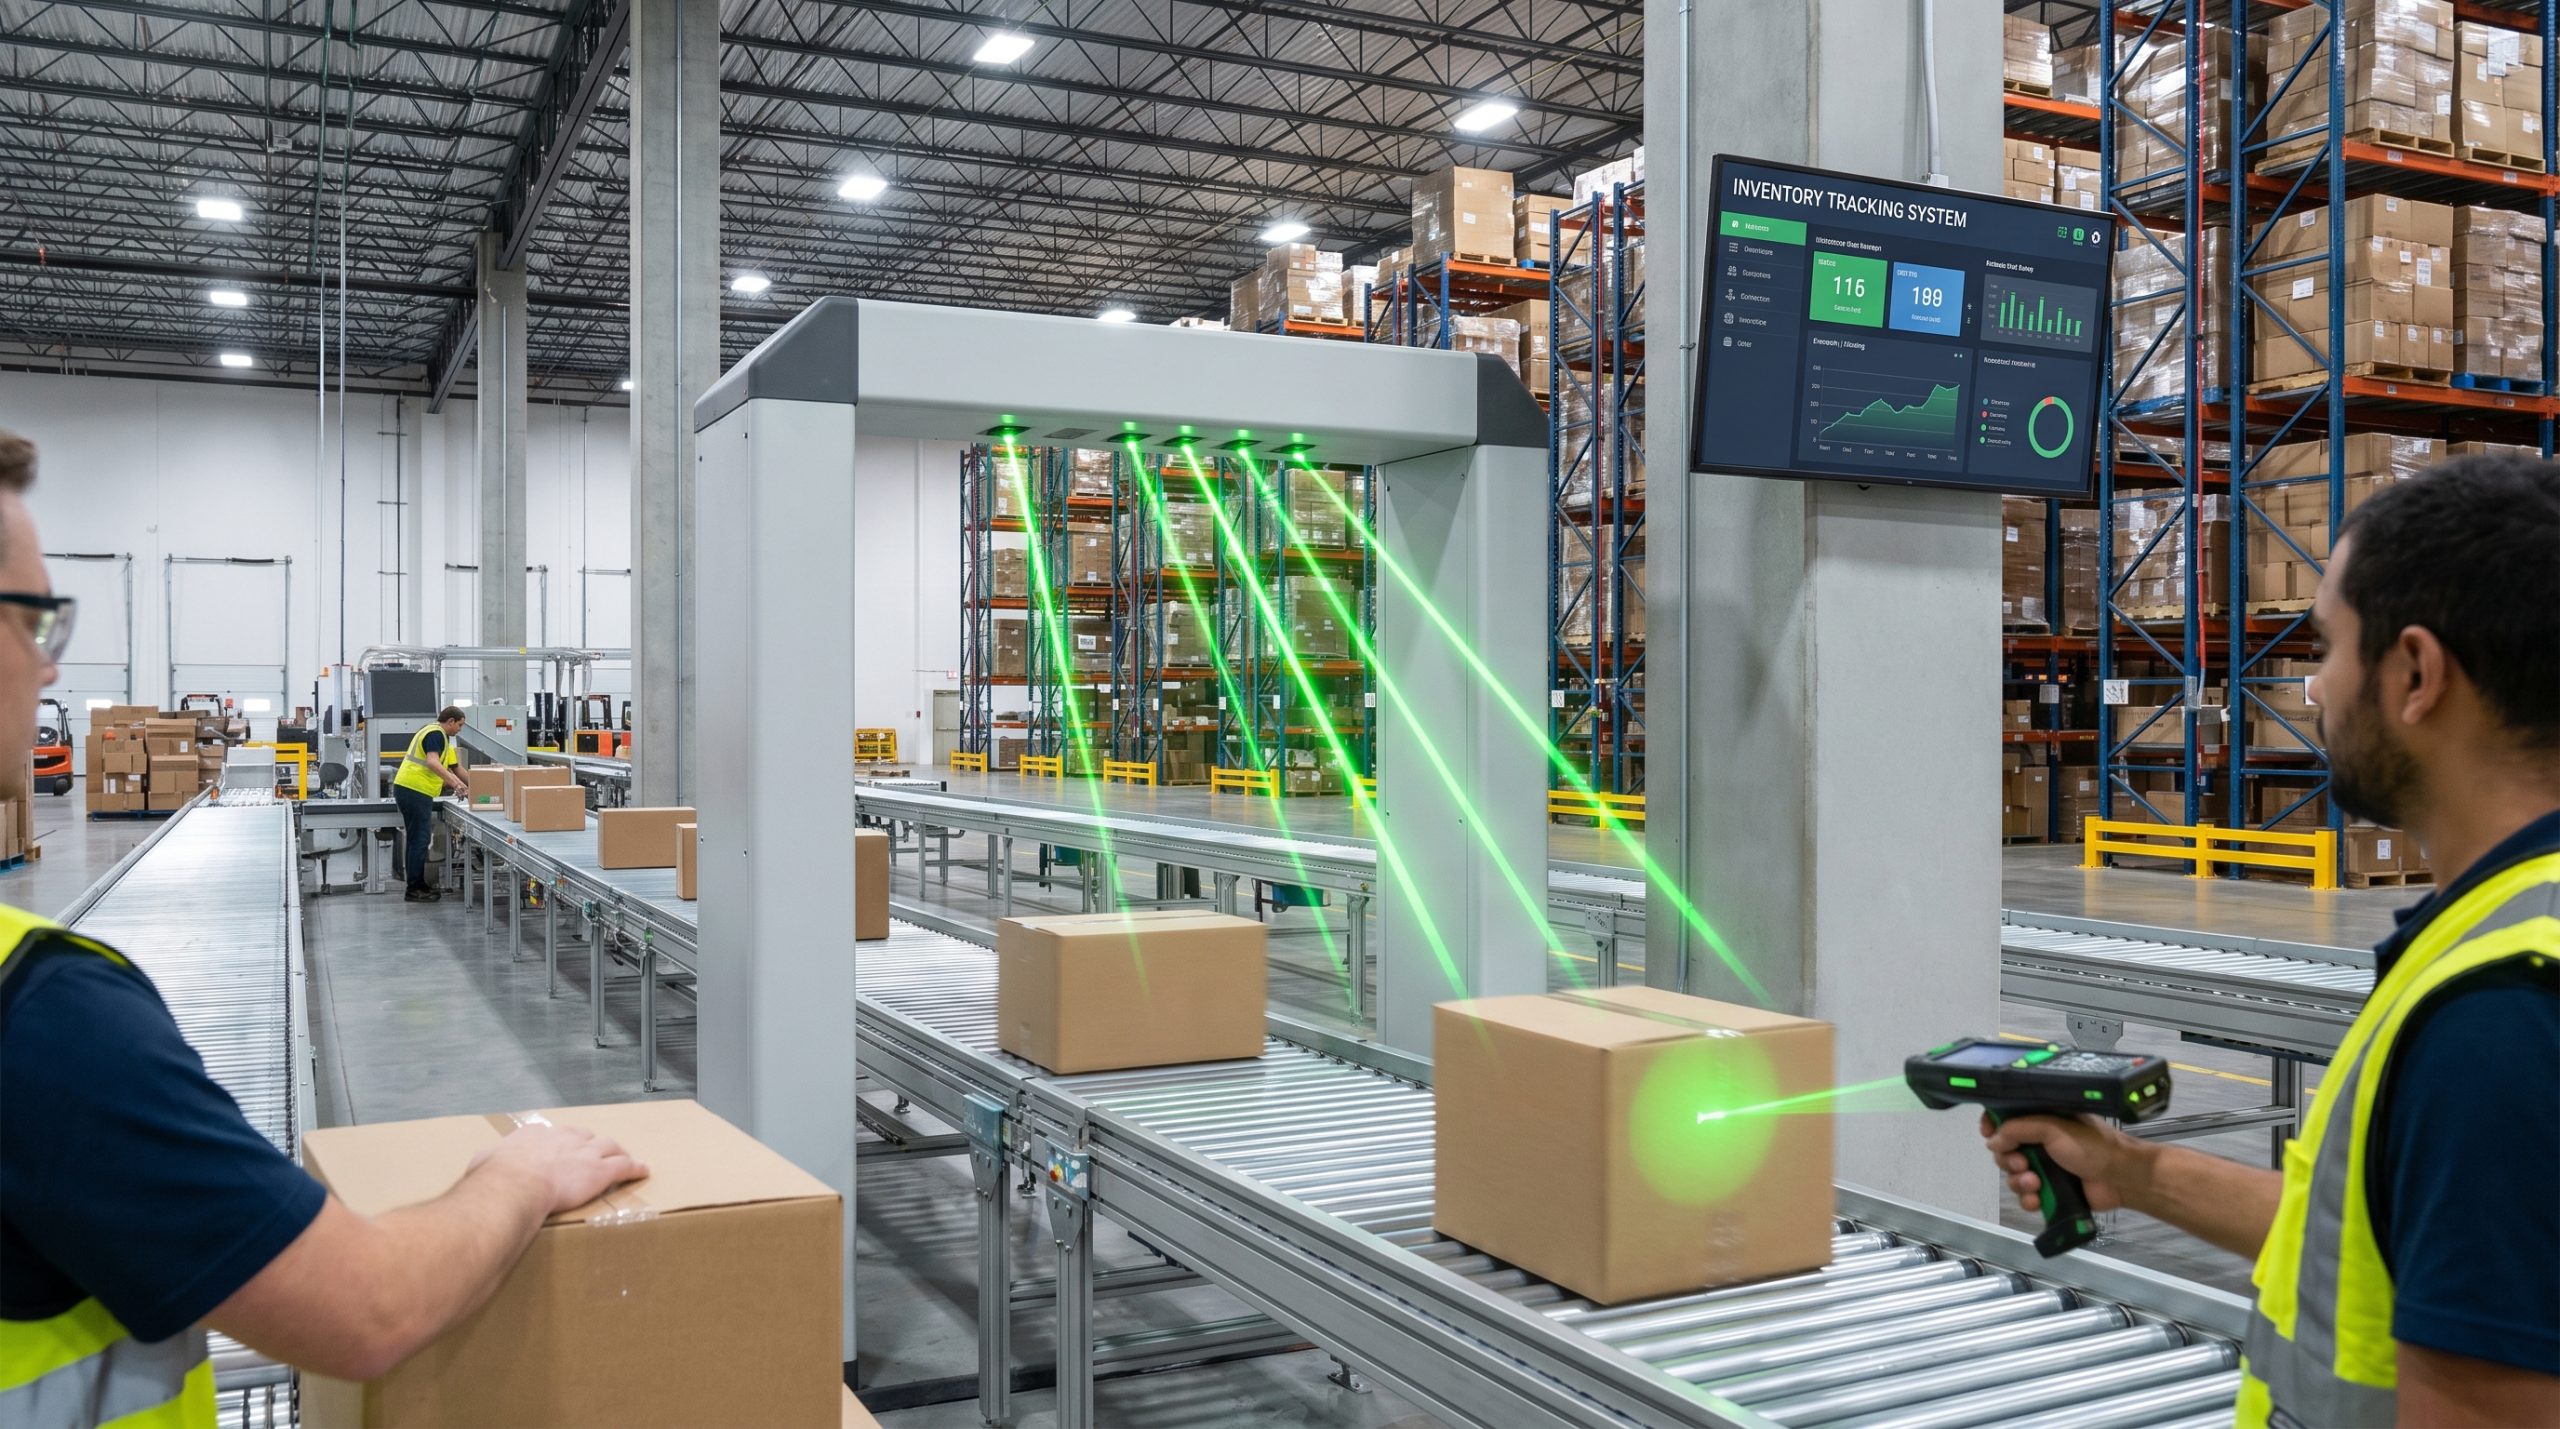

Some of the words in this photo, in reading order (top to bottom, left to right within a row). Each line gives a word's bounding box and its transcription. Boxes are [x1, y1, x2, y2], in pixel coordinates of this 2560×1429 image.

[1733, 177, 1824, 207] INVENTORY
[1827, 191, 1904, 219] TRACKING
[1907, 203, 1967, 229] SYSTEM
[1833, 275, 1865, 298] 116
